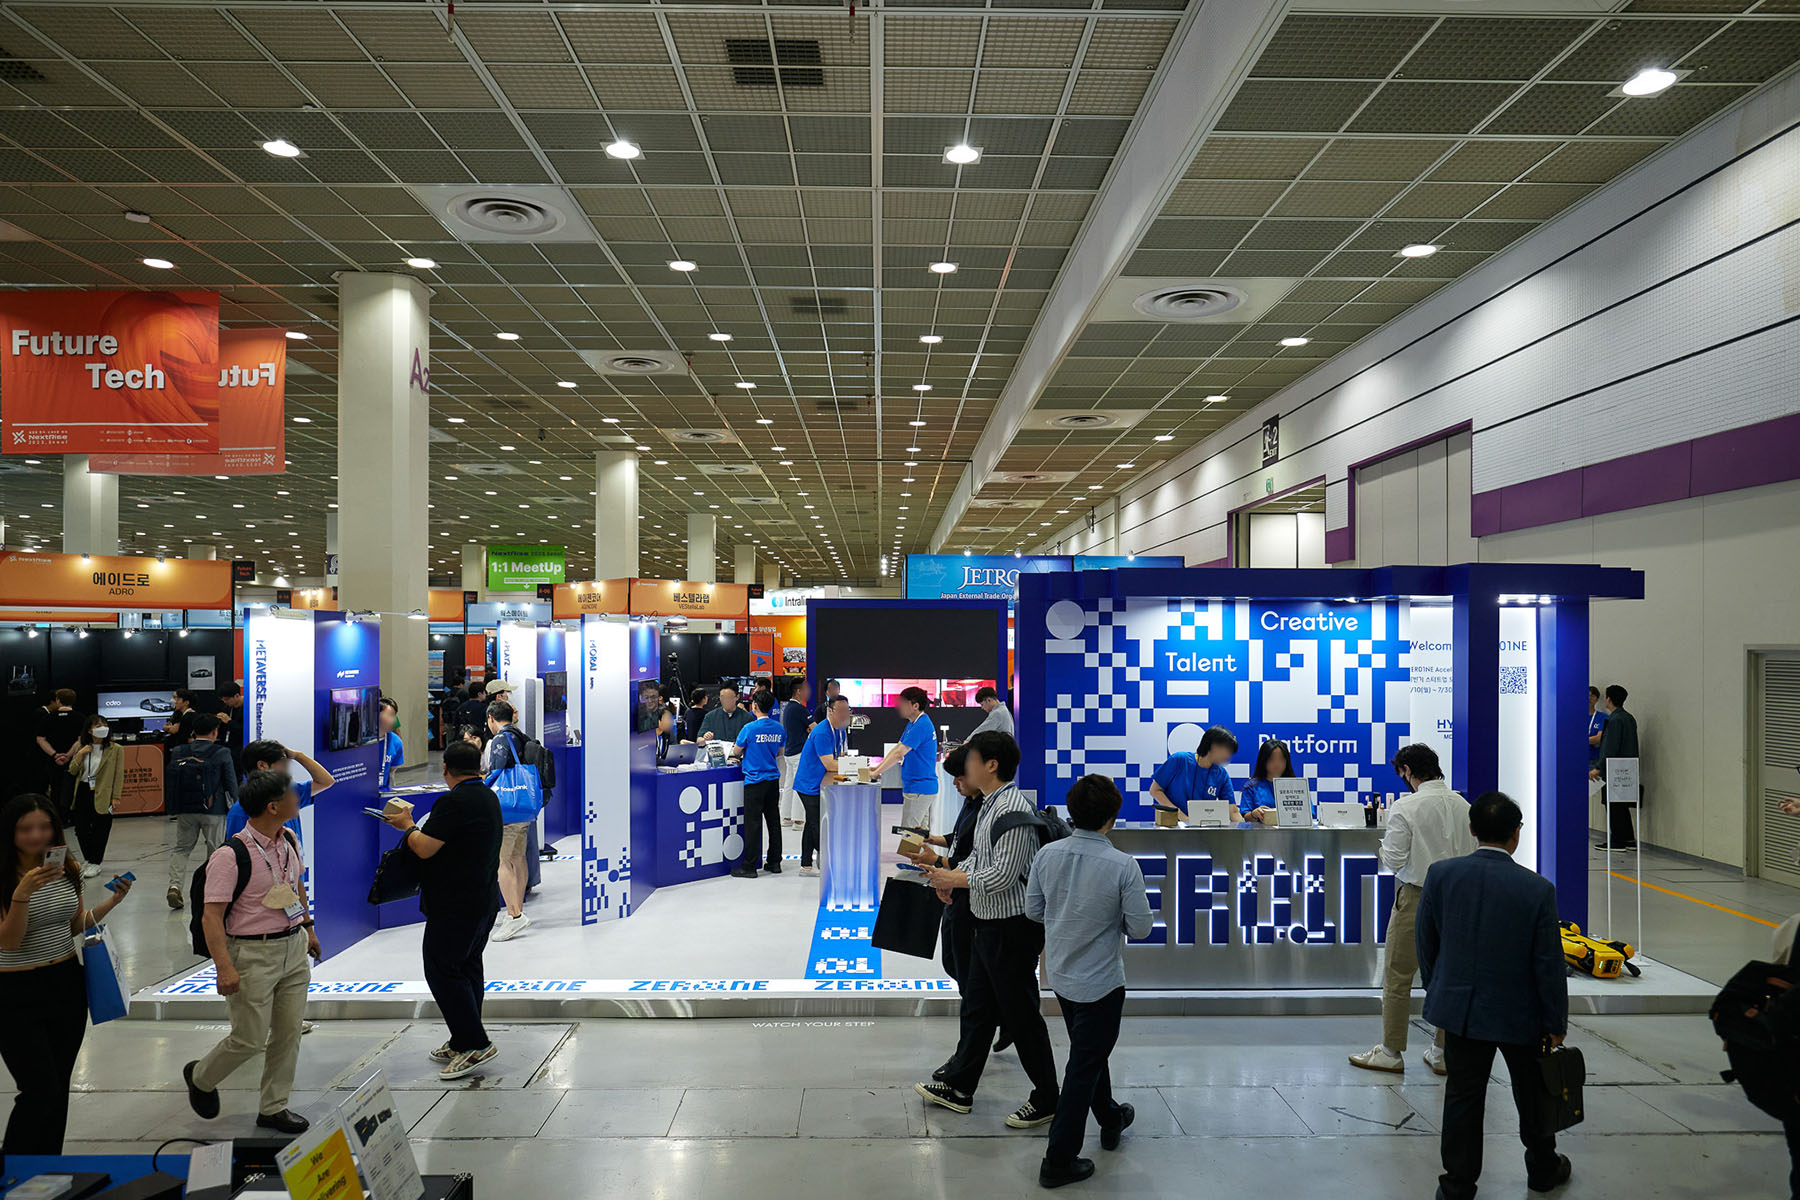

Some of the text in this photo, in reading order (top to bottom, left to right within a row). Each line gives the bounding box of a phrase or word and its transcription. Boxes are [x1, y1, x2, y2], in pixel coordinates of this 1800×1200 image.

[11, 329, 118, 356] Future
[85, 363, 165, 389] Tech
[28, 433, 68, 441] NextRise
[491, 561, 562, 575] 1:1 MeetUp
[92, 572, 151, 587] 에이드로
[957, 566, 1020, 590] JETRO
[108, 588, 134, 596] ADRO
[673, 593, 710, 604] 베스텔라랩
[940, 592, 957, 600] Japan
[1260, 610, 1359, 632] Creative
[589, 639, 598, 672] MORAI
[1165, 651, 1237, 672] Talent
[256, 640, 267, 702] METAVERSE
[310, 1151, 324, 1166] We
[317, 1168, 330, 1185] Are
